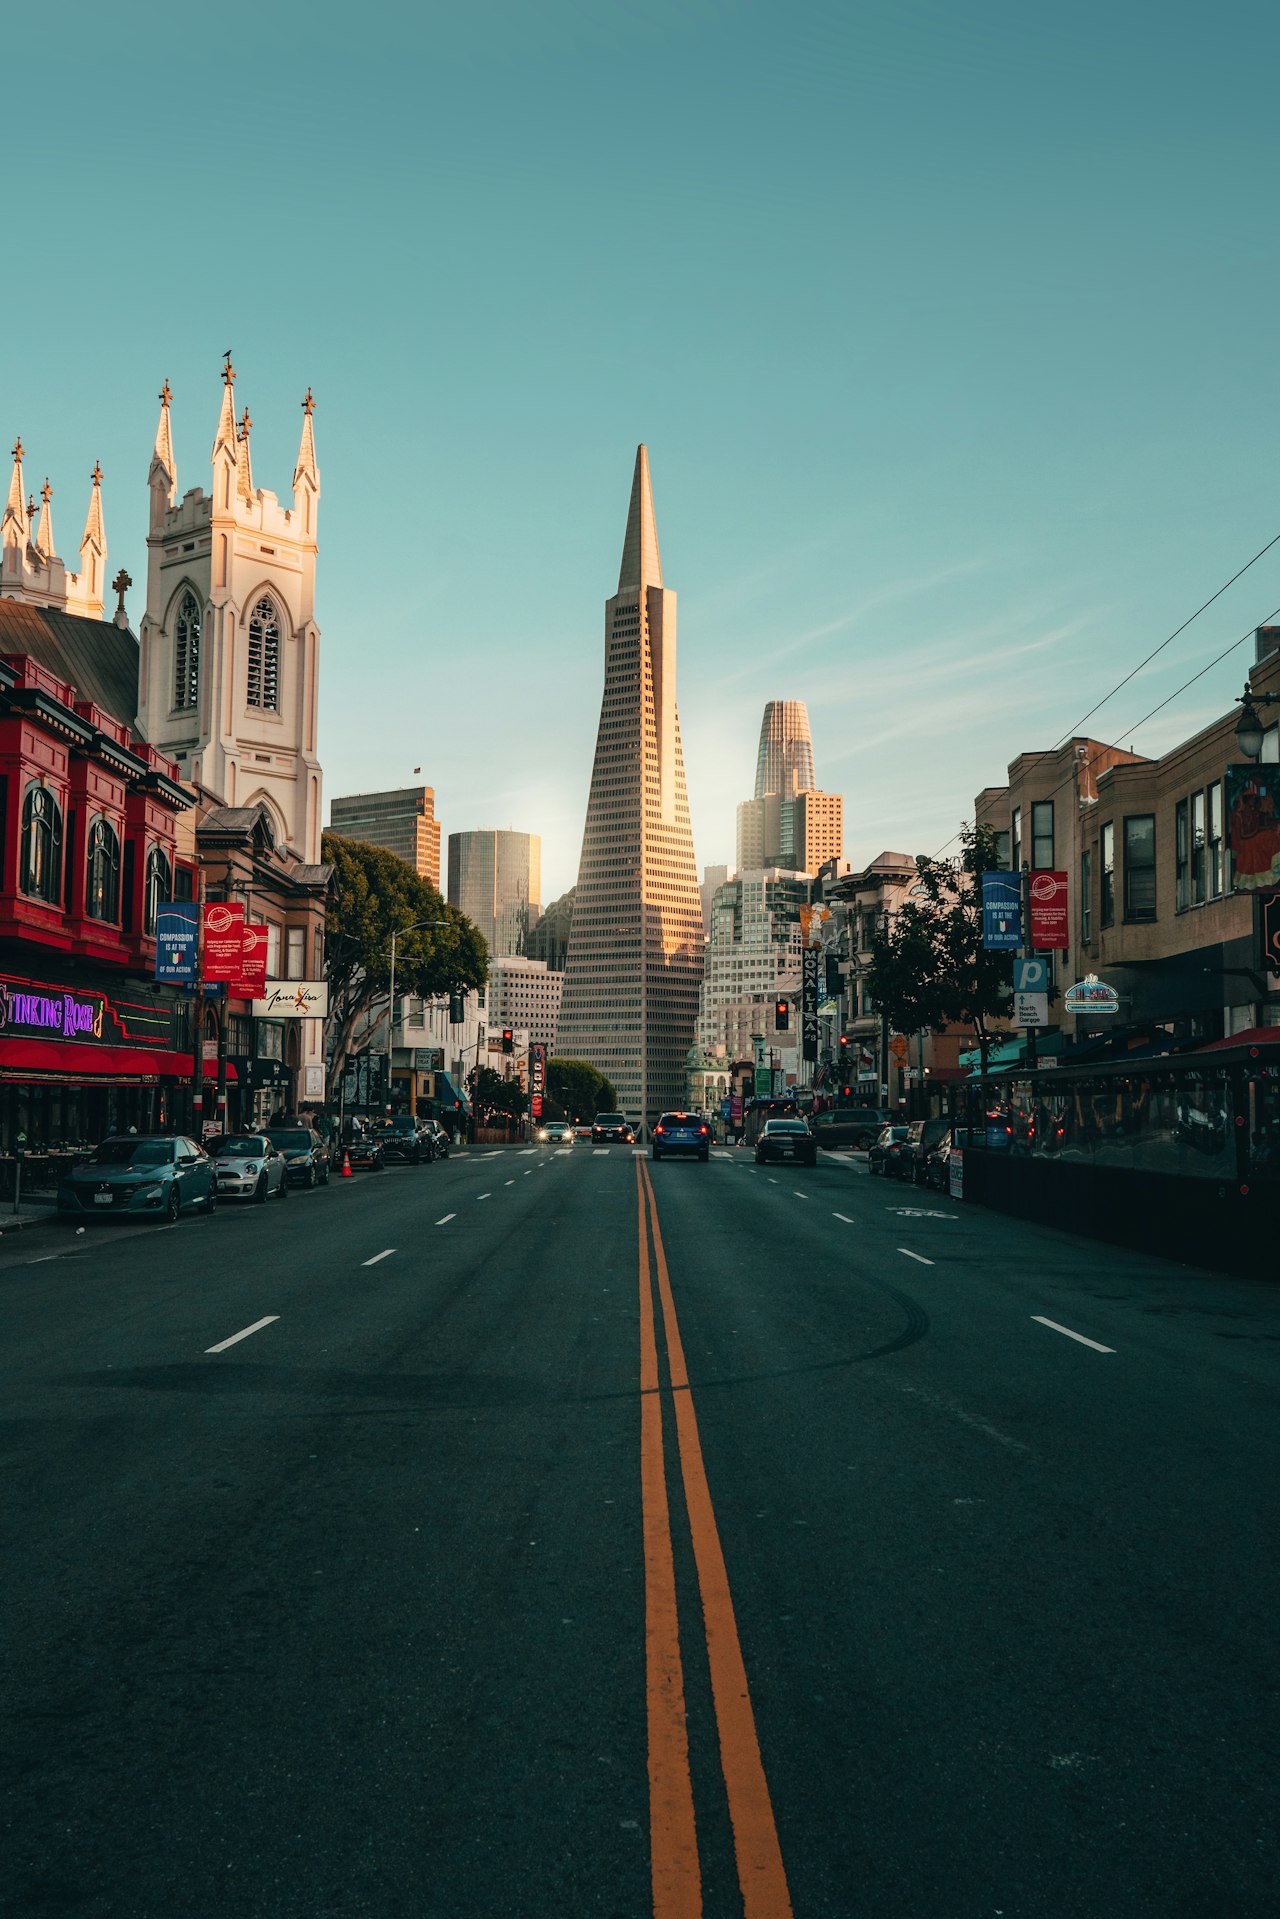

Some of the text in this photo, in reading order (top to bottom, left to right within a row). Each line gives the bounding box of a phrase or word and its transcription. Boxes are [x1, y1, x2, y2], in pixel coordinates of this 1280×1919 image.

[985, 902, 1018, 910] COMPASSION
[159, 933, 193, 942] COMPASSION
[165, 943, 187, 951] IS AT THE
[176, 966, 191, 974] ACTION
[804, 950, 816, 1031] MONA LISA
[294, 988, 323, 1007] Lisa
[63, 994, 94, 1036] ROSE
